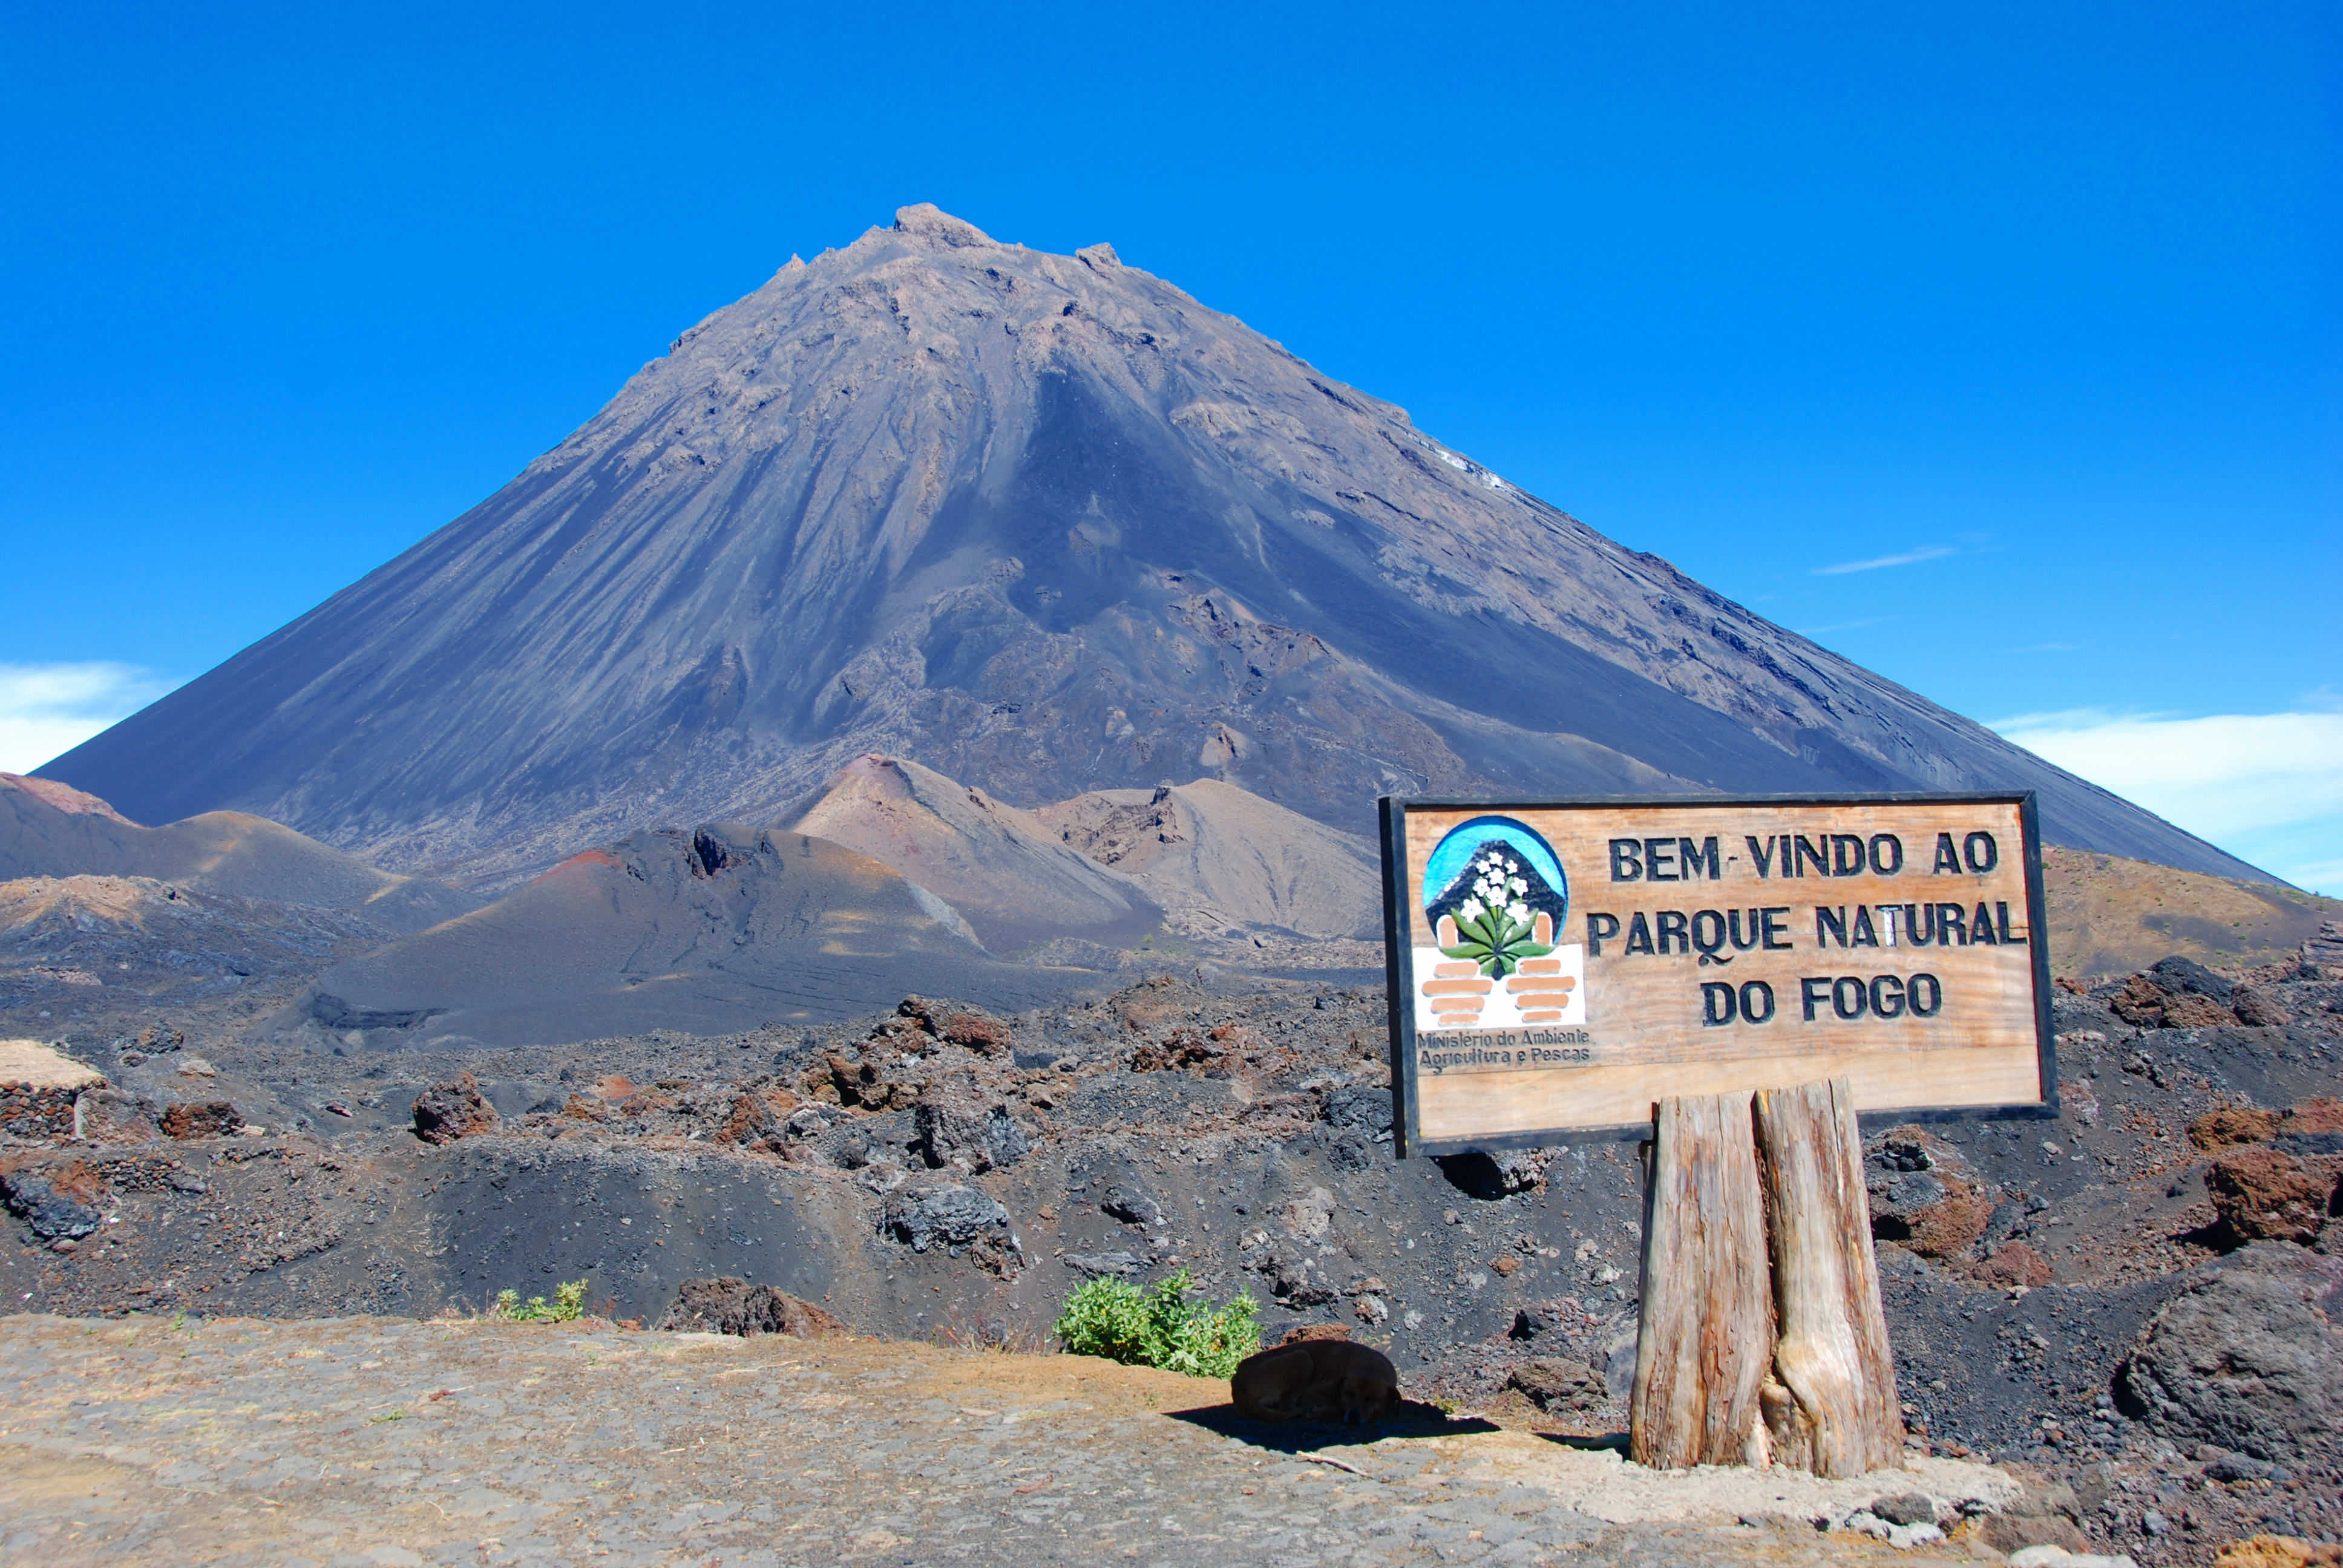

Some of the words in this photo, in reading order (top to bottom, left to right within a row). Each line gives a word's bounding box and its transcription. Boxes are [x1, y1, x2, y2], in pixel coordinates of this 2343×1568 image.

[1934, 831, 1999, 875] AO
[1586, 906, 1794, 966] PARQUE
[1816, 901, 2028, 950] NATURAL
[1701, 979, 1775, 1027] DO
[1801, 973, 1942, 1022] FOGO
[1497, 1030, 1516, 1047] do
[1420, 1048, 1512, 1074] Agricultura
[1516, 1051, 1526, 1065] e
[1531, 1048, 1590, 1062] Pescas
